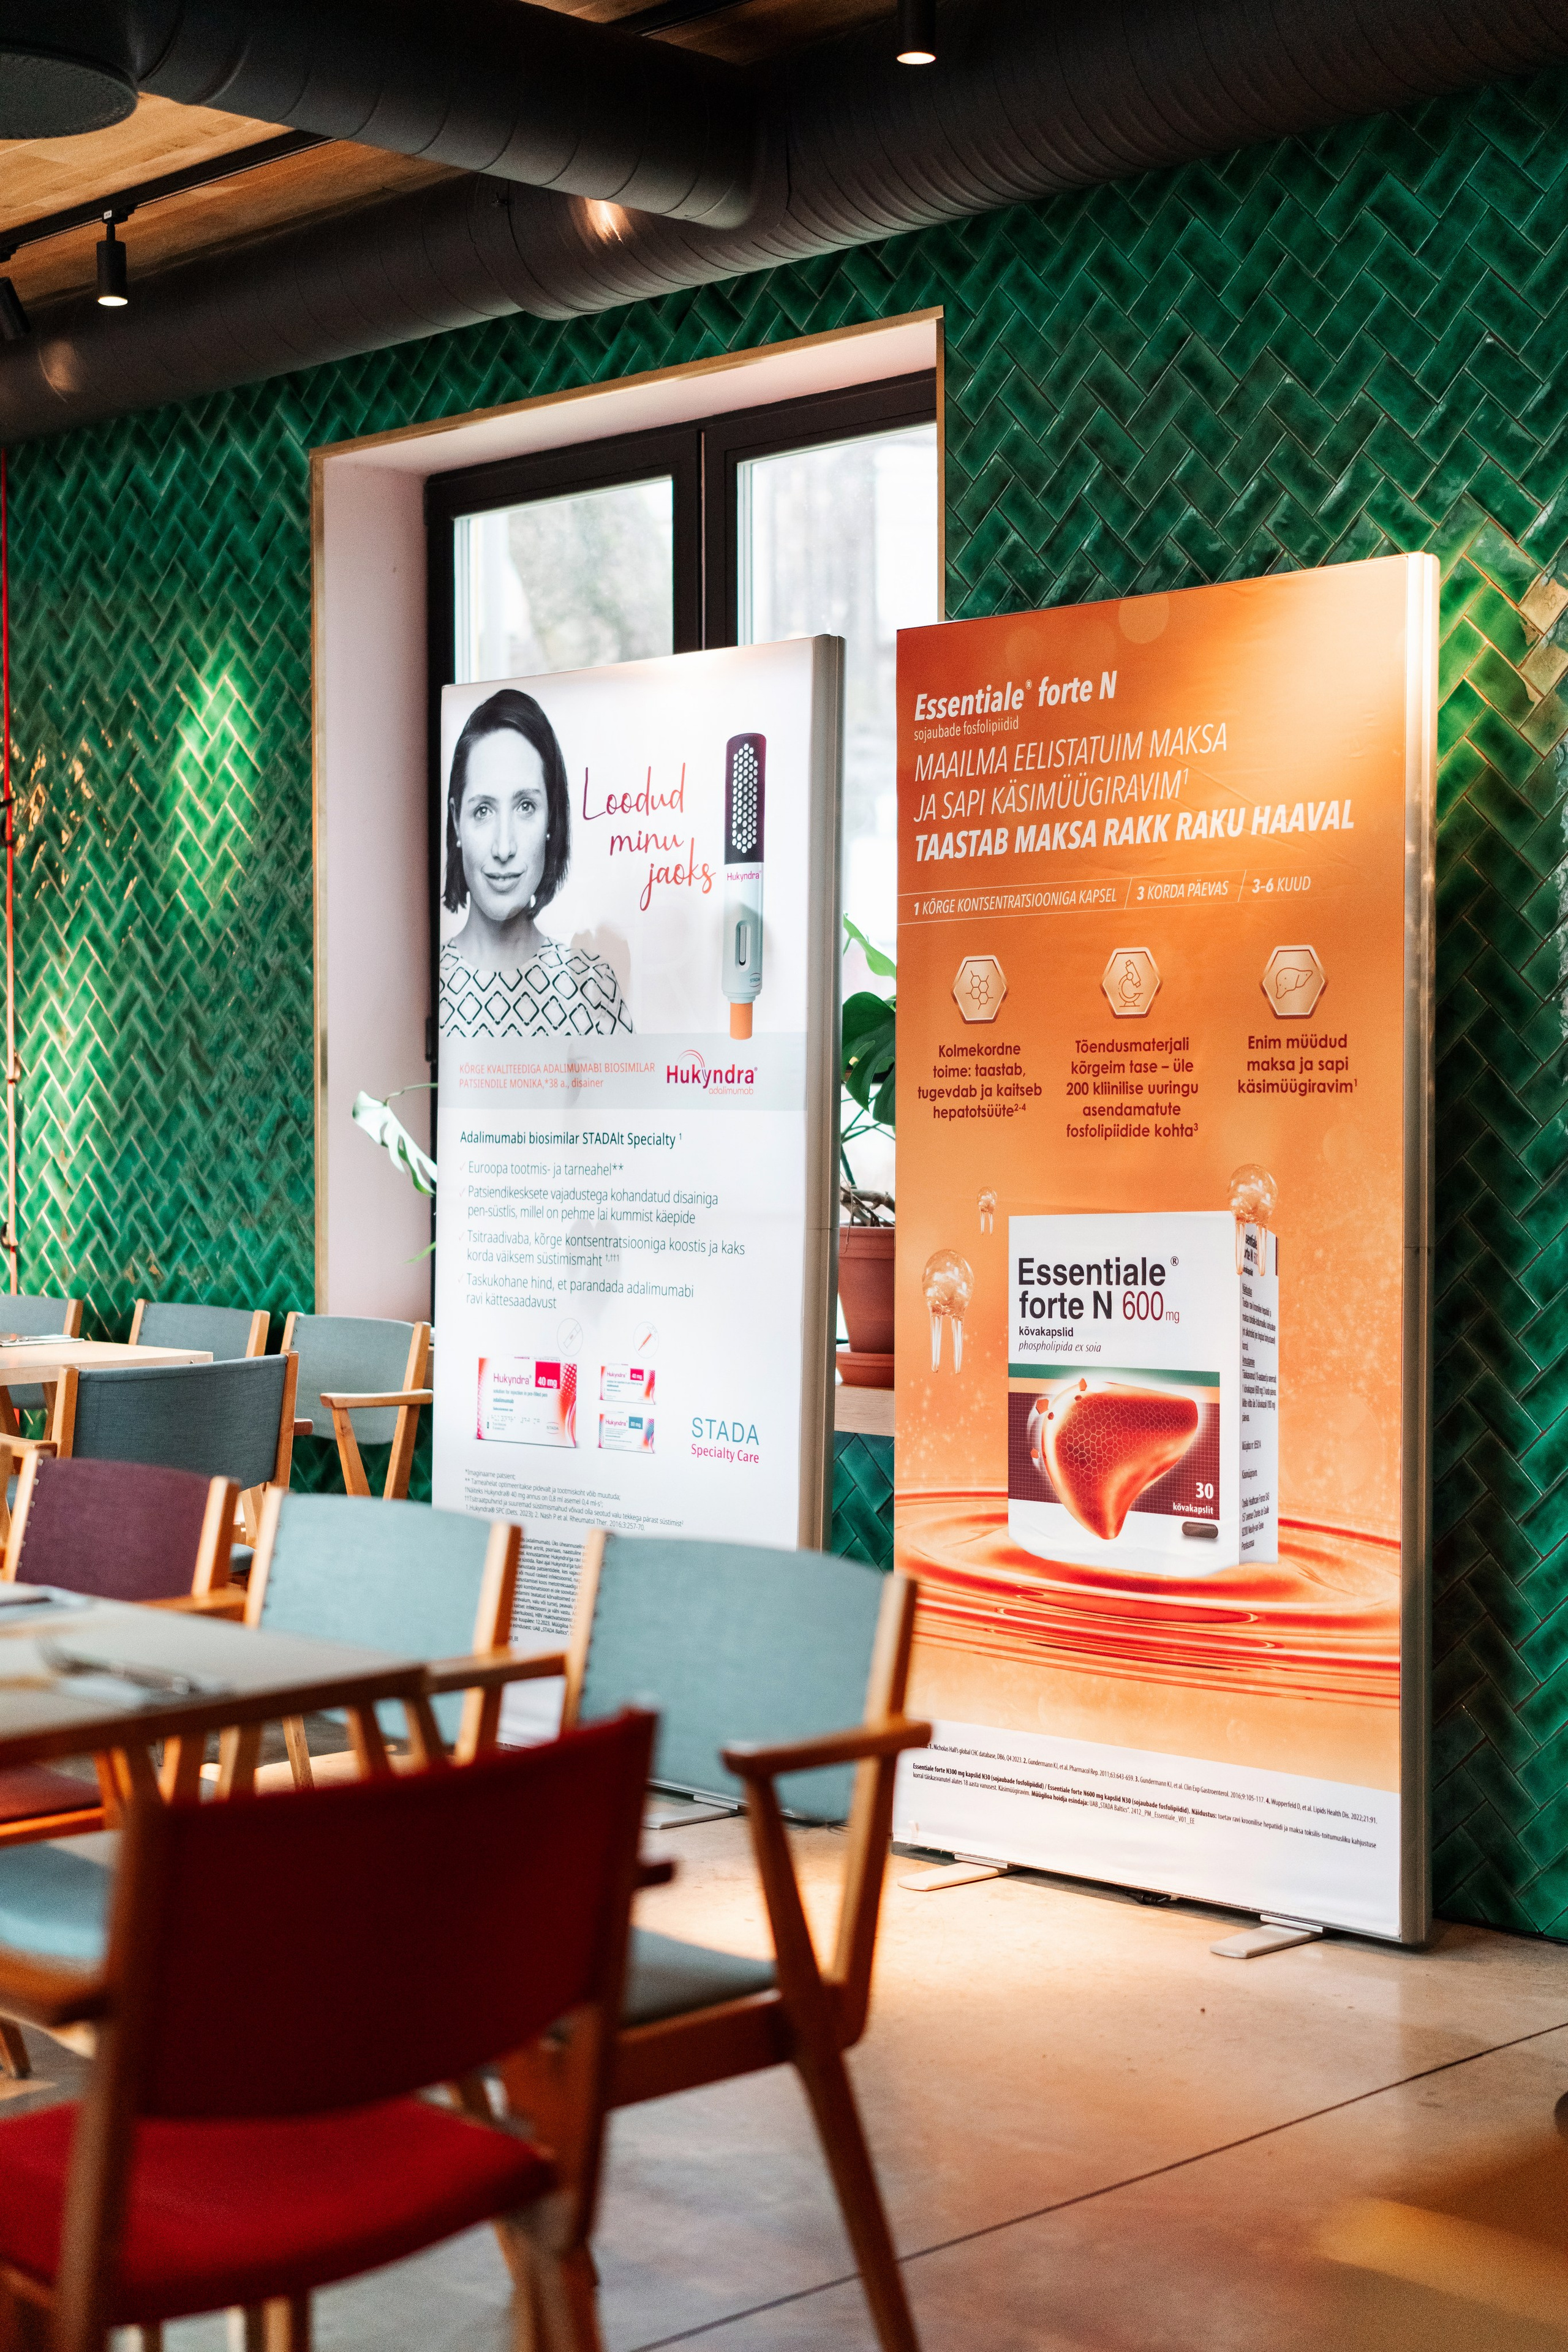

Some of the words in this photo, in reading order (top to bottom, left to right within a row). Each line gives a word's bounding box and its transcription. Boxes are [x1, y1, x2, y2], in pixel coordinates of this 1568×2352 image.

[1038, 676, 1092, 706] forte
[1099, 670, 1117, 699] N
[914, 722, 960, 742] sojaubade
[963, 715, 1018, 736] fosfolipiidid
[914, 745, 1007, 782] MAAILMA
[1014, 731, 1142, 771] EELISTATUIM
[1149, 722, 1226, 758] MAKSA
[582, 762, 685, 820] Loodud
[913, 793, 935, 822] JA
[941, 788, 985, 819] SAPI
[915, 828, 1009, 862] TAASTAB
[1014, 821, 1098, 854] MAKSA
[1103, 813, 1172, 847] RAKK
[1175, 807, 1246, 841] RAKU
[1251, 799, 1355, 835] HAAVAL
[609, 831, 684, 856] minu
[639, 837, 716, 911] jaoks
[1136, 886, 1144, 900] 3
[1147, 883, 1184, 899] KORDA
[1187, 879, 1229, 897] PÄEVAS
[1251, 878, 1273, 893] 3-6
[1276, 876, 1311, 891] KUUD
[914, 902, 919, 915] 1
[922, 897, 955, 914] KÕRGE
[957, 891, 1076, 912] KONTSENTRATSIOONIGA
[1079, 888, 1116, 903] KAPSEL
[938, 1042, 1020, 1057] Kolmekordne
[1075, 1036, 1189, 1054] Tõendusmaterjali
[1248, 1035, 1281, 1049] Enim
[1286, 1033, 1347, 1048] müüdud
[460, 1065, 484, 1074] KÕRGE
[487, 1064, 541, 1074] KVALITEEDIGA
[543, 1063, 602, 1073] ADALIMUMABI
[605, 1062, 655, 1072] BIOSIMILAR
[933, 1065, 971, 1078] toime:
[974, 1062, 1025, 1077] taastab,
[1071, 1060, 1125, 1077] kõrgeim
[1129, 1060, 1157, 1073] tase
[1173, 1058, 1193, 1072] üle
[1247, 1057, 1295, 1071] maksa
[1298, 1056, 1313, 1074] ja
[1318, 1056, 1348, 1074] sapi
[459, 1078, 508, 1088] PATSIENDILE
[571, 1078, 604, 1088] disainer
[708, 1086, 755, 1095] adalimumab
[917, 1084, 977, 1101] tugevdab
[979, 1084, 992, 1100] ja
[997, 1082, 1042, 1096] kaitseb
[1066, 1082, 1088, 1095] 200
[1093, 1080, 1143, 1095] kliinilise
[1148, 1080, 1198, 1097] uuringu
[1082, 1102, 1180, 1116] asendamatute
[460, 1131, 525, 1144] Adalimumabi
[529, 1131, 579, 1144] biosimilar
[627, 1132, 676, 1149] Specialty
[1066, 1123, 1150, 1140] fosfolipiidide
[469, 1161, 507, 1176] Euroopa
[510, 1162, 550, 1174] tootmis-
[552, 1162, 561, 1177] ja
[469, 1185, 548, 1199] Patsiendikesksete
[550, 1187, 608, 1204] vajadustega
[611, 1188, 670, 1202] kohandatud
[673, 1189, 718, 1208] disainiga
[468, 1204, 517, 1218] pen-süstlis,
[520, 1205, 543, 1218] millel
[546, 1208, 558, 1218] on
[561, 1206, 594, 1222] pehme
[597, 1207, 608, 1220] lai
[611, 1207, 653, 1222] kummist
[655, 1208, 695, 1226] käepide
[467, 1229, 530, 1245] Tsitraadivaba,
[534, 1232, 562, 1249] kõrge
[565, 1234, 665, 1253] kontsentratsiooniga
[669, 1237, 706, 1252] koostis
[707, 1240, 717, 1256] ja
[722, 1240, 745, 1254] kaks
[467, 1248, 493, 1261] korda
[496, 1250, 533, 1263] väiksem
[537, 1252, 602, 1267] süstimismaht
[467, 1273, 528, 1288] Taskukohane
[531, 1276, 554, 1291] hind,
[557, 1279, 567, 1290] et
[570, 1278, 623, 1294] parandada
[627, 1281, 693, 1297] adalimumabi
[466, 1294, 482, 1303] ravi
[486, 1292, 556, 1308] kättesaadavust
[1019, 1290, 1084, 1319] forte
[1093, 1291, 1112, 1319] N
[1123, 1291, 1163, 1321] 600
[1166, 1311, 1179, 1323] mg
[1019, 1325, 1073, 1338] kõvakapslid
[1018, 1340, 1072, 1352] phospholipida
[1085, 1341, 1101, 1352] soia
[692, 1417, 759, 1445] STADA
[691, 1443, 734, 1463] Specialty
[737, 1449, 759, 1463] Care
[1196, 1482, 1213, 1499] 30
[1173, 1502, 1213, 1514] kõvakapslit
[913, 1763, 933, 1771] Essentiale
[965, 1770, 981, 1779] kapslid
[990, 1774, 1015, 1784] (sojaubade
[1016, 1778, 1044, 1789] fosfolipiidid)
[1047, 1784, 1070, 1793] Essentiale
[1104, 1793, 1121, 1802] kapslid
[1131, 1798, 1158, 1808] (sojaubade
[1158, 1803, 1190, 1814] fosfolipiidid).
[1191, 1808, 1216, 1818] Näidustus:
[1241, 1817, 1262, 1826] kroonilise
[1263, 1820, 1283, 1830] hepatiidi
[1304, 1829, 1350, 1843] toksilis-toitumusliku
[1351, 1837, 1376, 1848] kahjustuse
